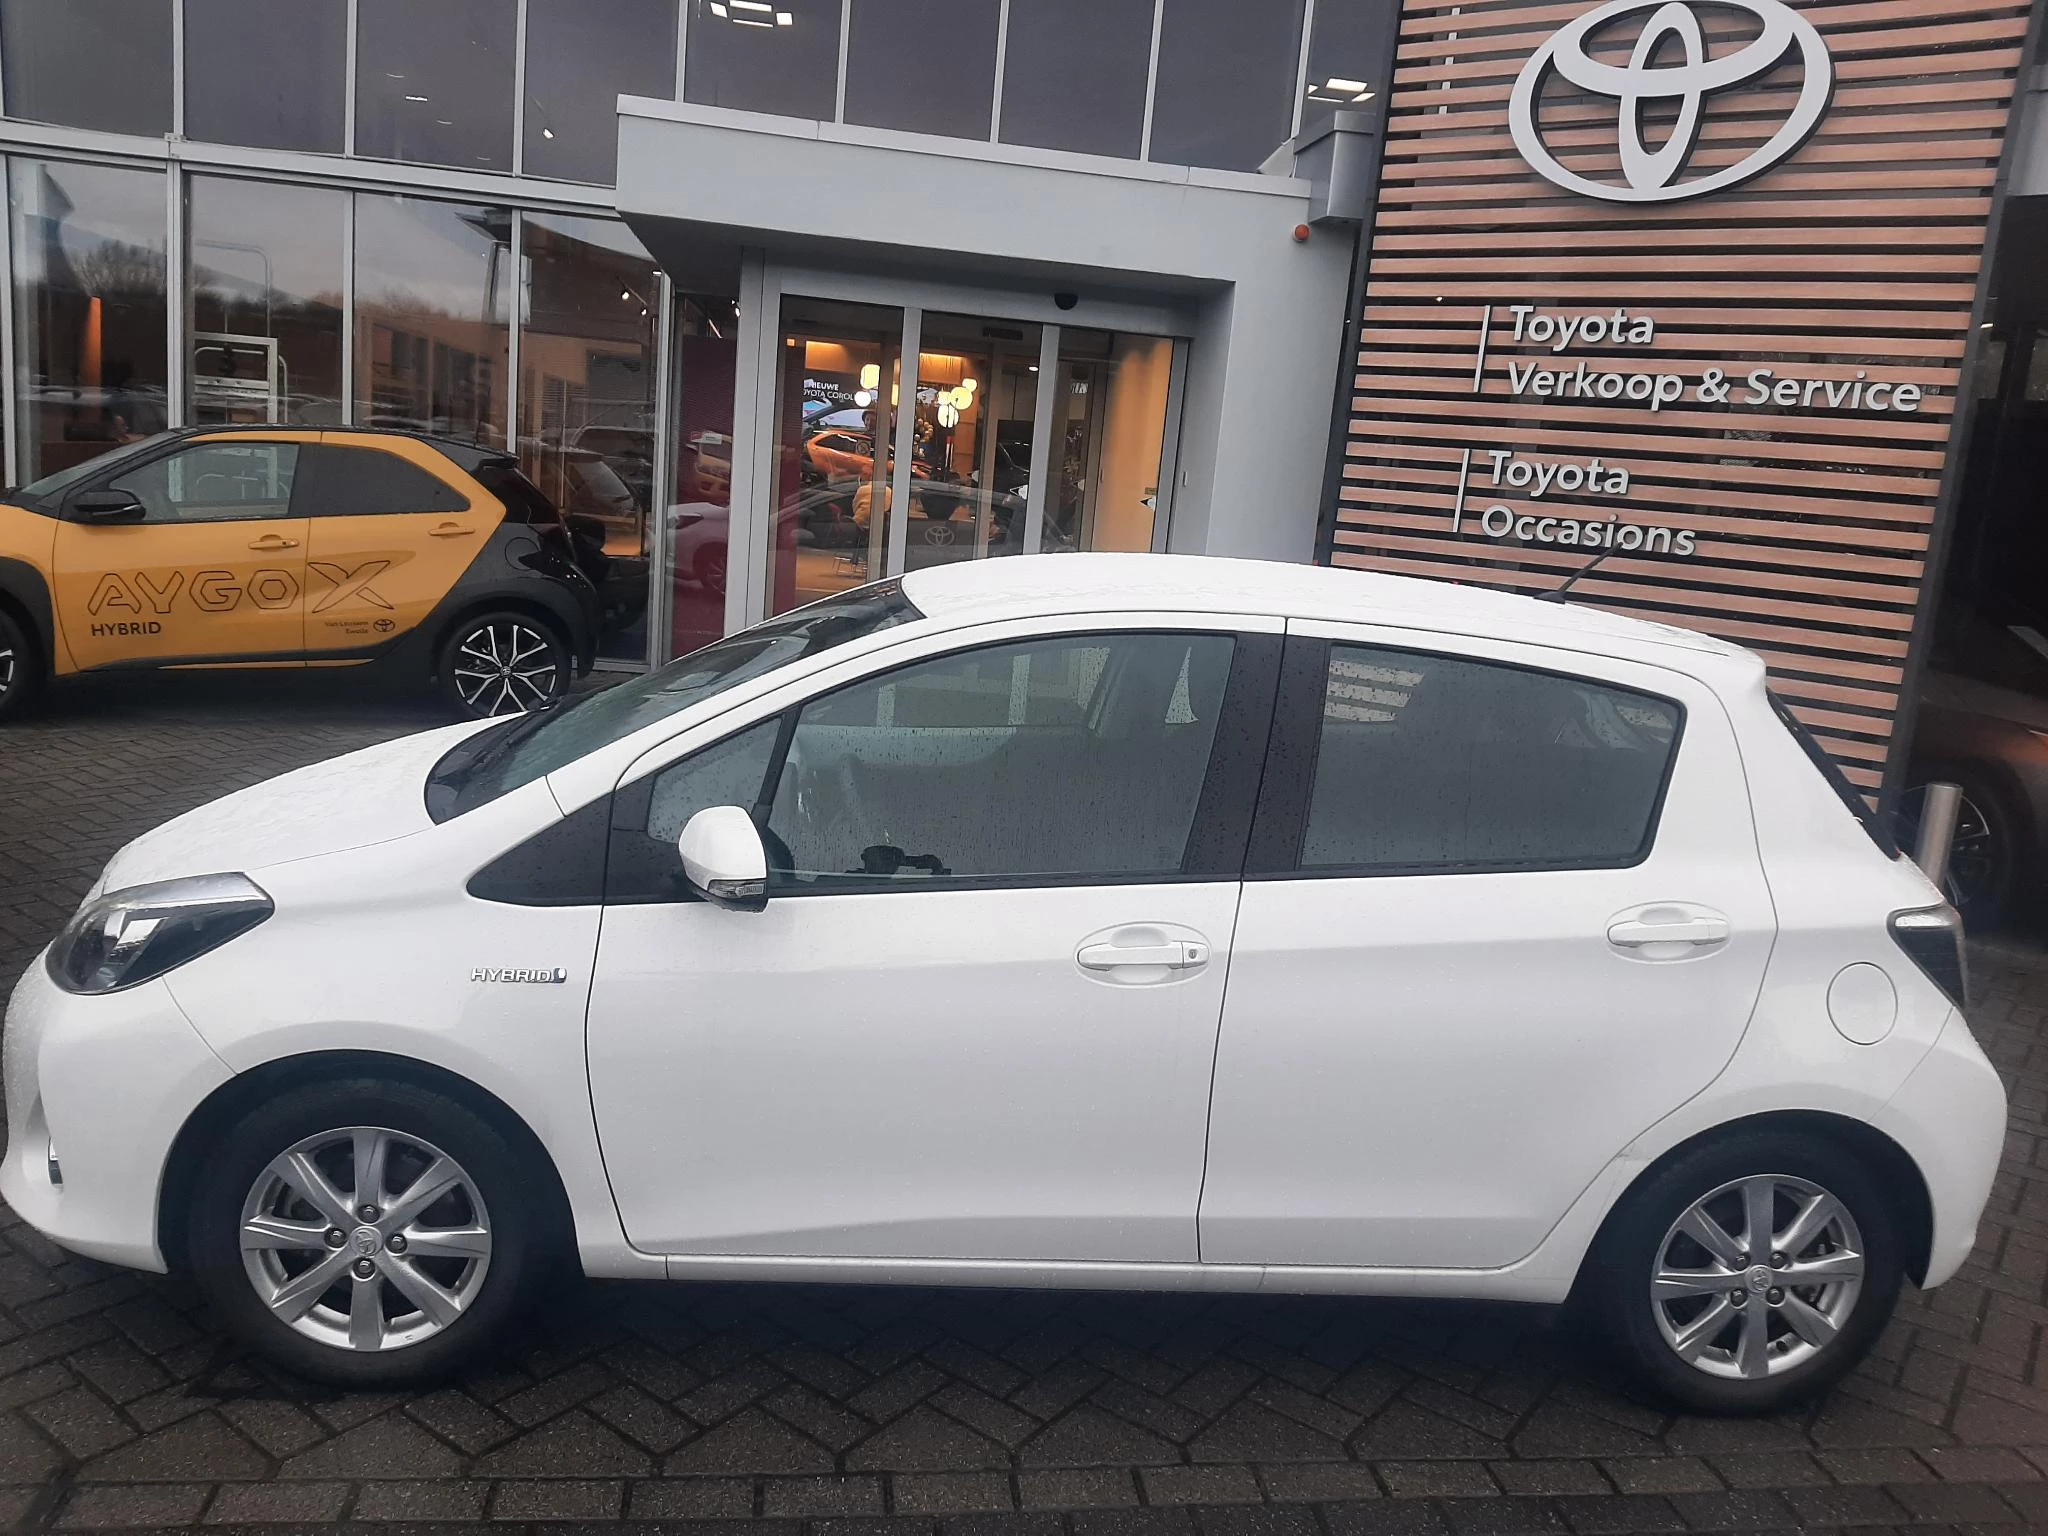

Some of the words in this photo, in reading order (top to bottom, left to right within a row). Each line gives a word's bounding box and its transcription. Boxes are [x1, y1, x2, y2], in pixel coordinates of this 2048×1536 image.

[1509, 304, 1656, 353] Toyota
[1507, 361, 1684, 412] Verkoop
[1696, 367, 1732, 405] &
[1744, 370, 1922, 413] Service
[1488, 449, 1631, 498] Toyota
[1480, 504, 1697, 556] Occasions
[87, 569, 299, 616] AYGO
[91, 621, 162, 637] HYBRID
[470, 967, 552, 984] HYBRID
